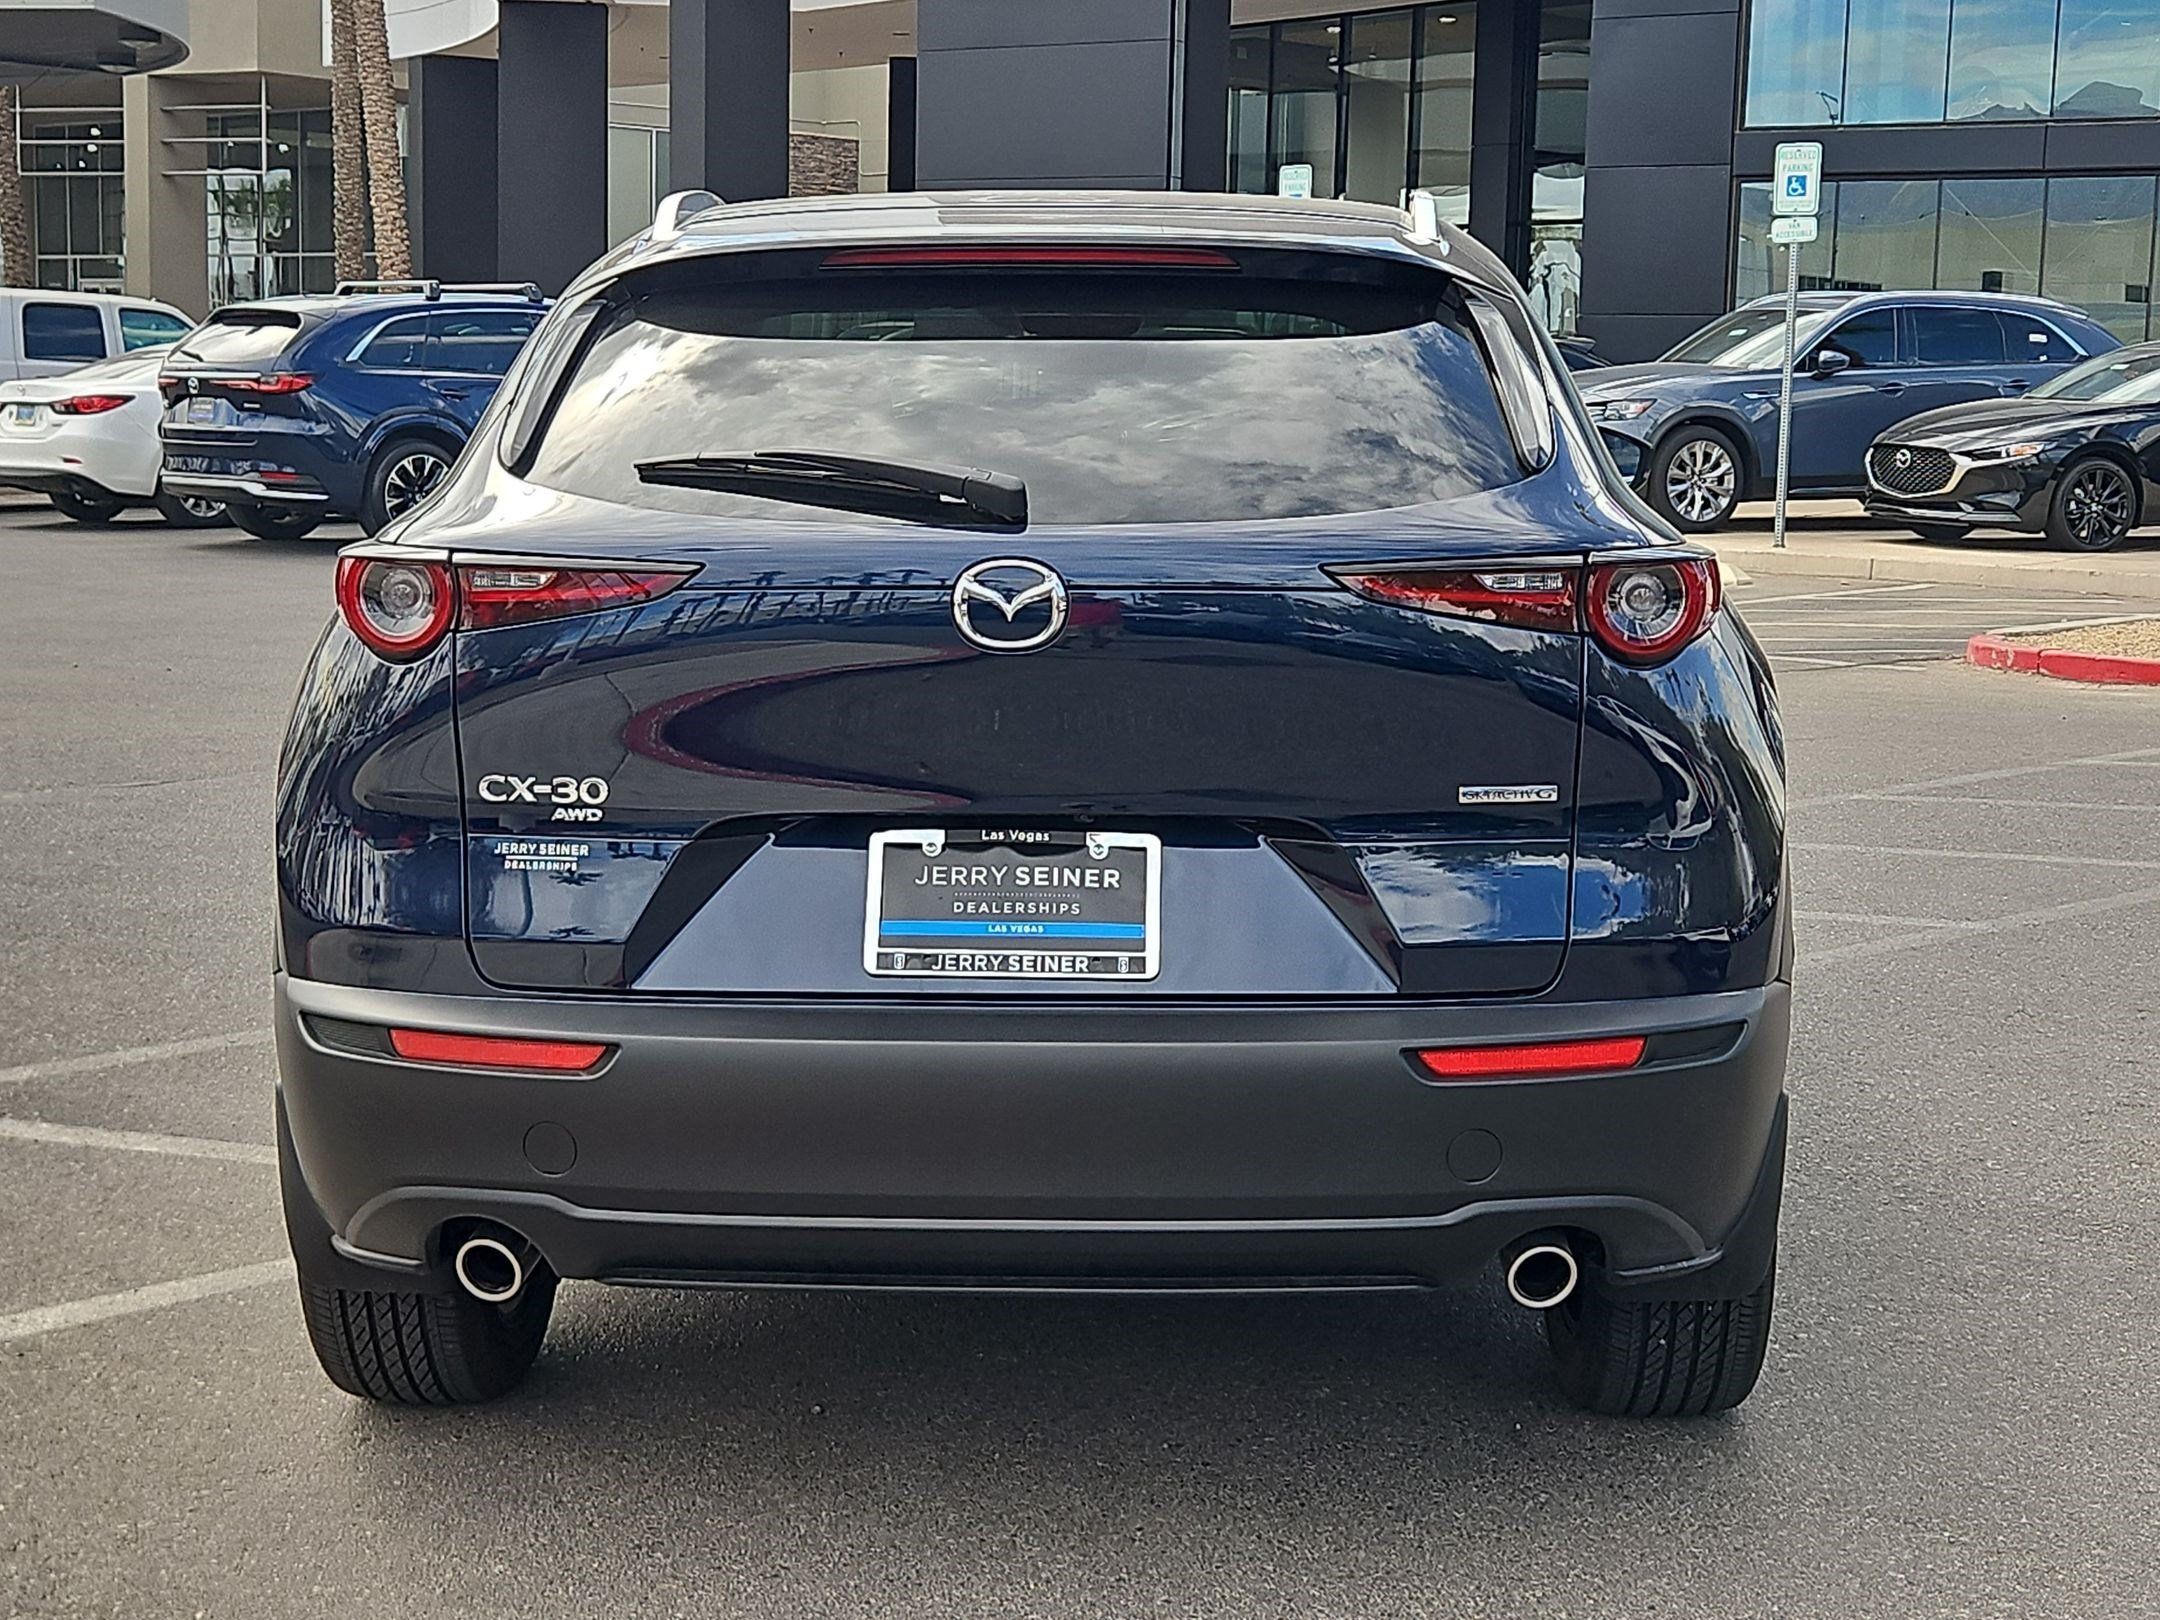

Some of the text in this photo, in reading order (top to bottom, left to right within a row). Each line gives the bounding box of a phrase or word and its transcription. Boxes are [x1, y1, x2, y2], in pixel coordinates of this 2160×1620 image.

[1782, 163, 1814, 173] PARKING
[478, 774, 609, 805] CX-30
[551, 807, 603, 822] AWD
[981, 830, 1050, 843] Las Vegas
[494, 842, 589, 857] JERRY SEINER
[503, 860, 578, 872] DEALERSHIPS
[914, 865, 1121, 889] JERRY SEINER
[953, 901, 1081, 915] DEALERSHIPS
[987, 925, 1045, 934] LAS VEGAS
[931, 954, 1089, 973] JERRY SEINER
